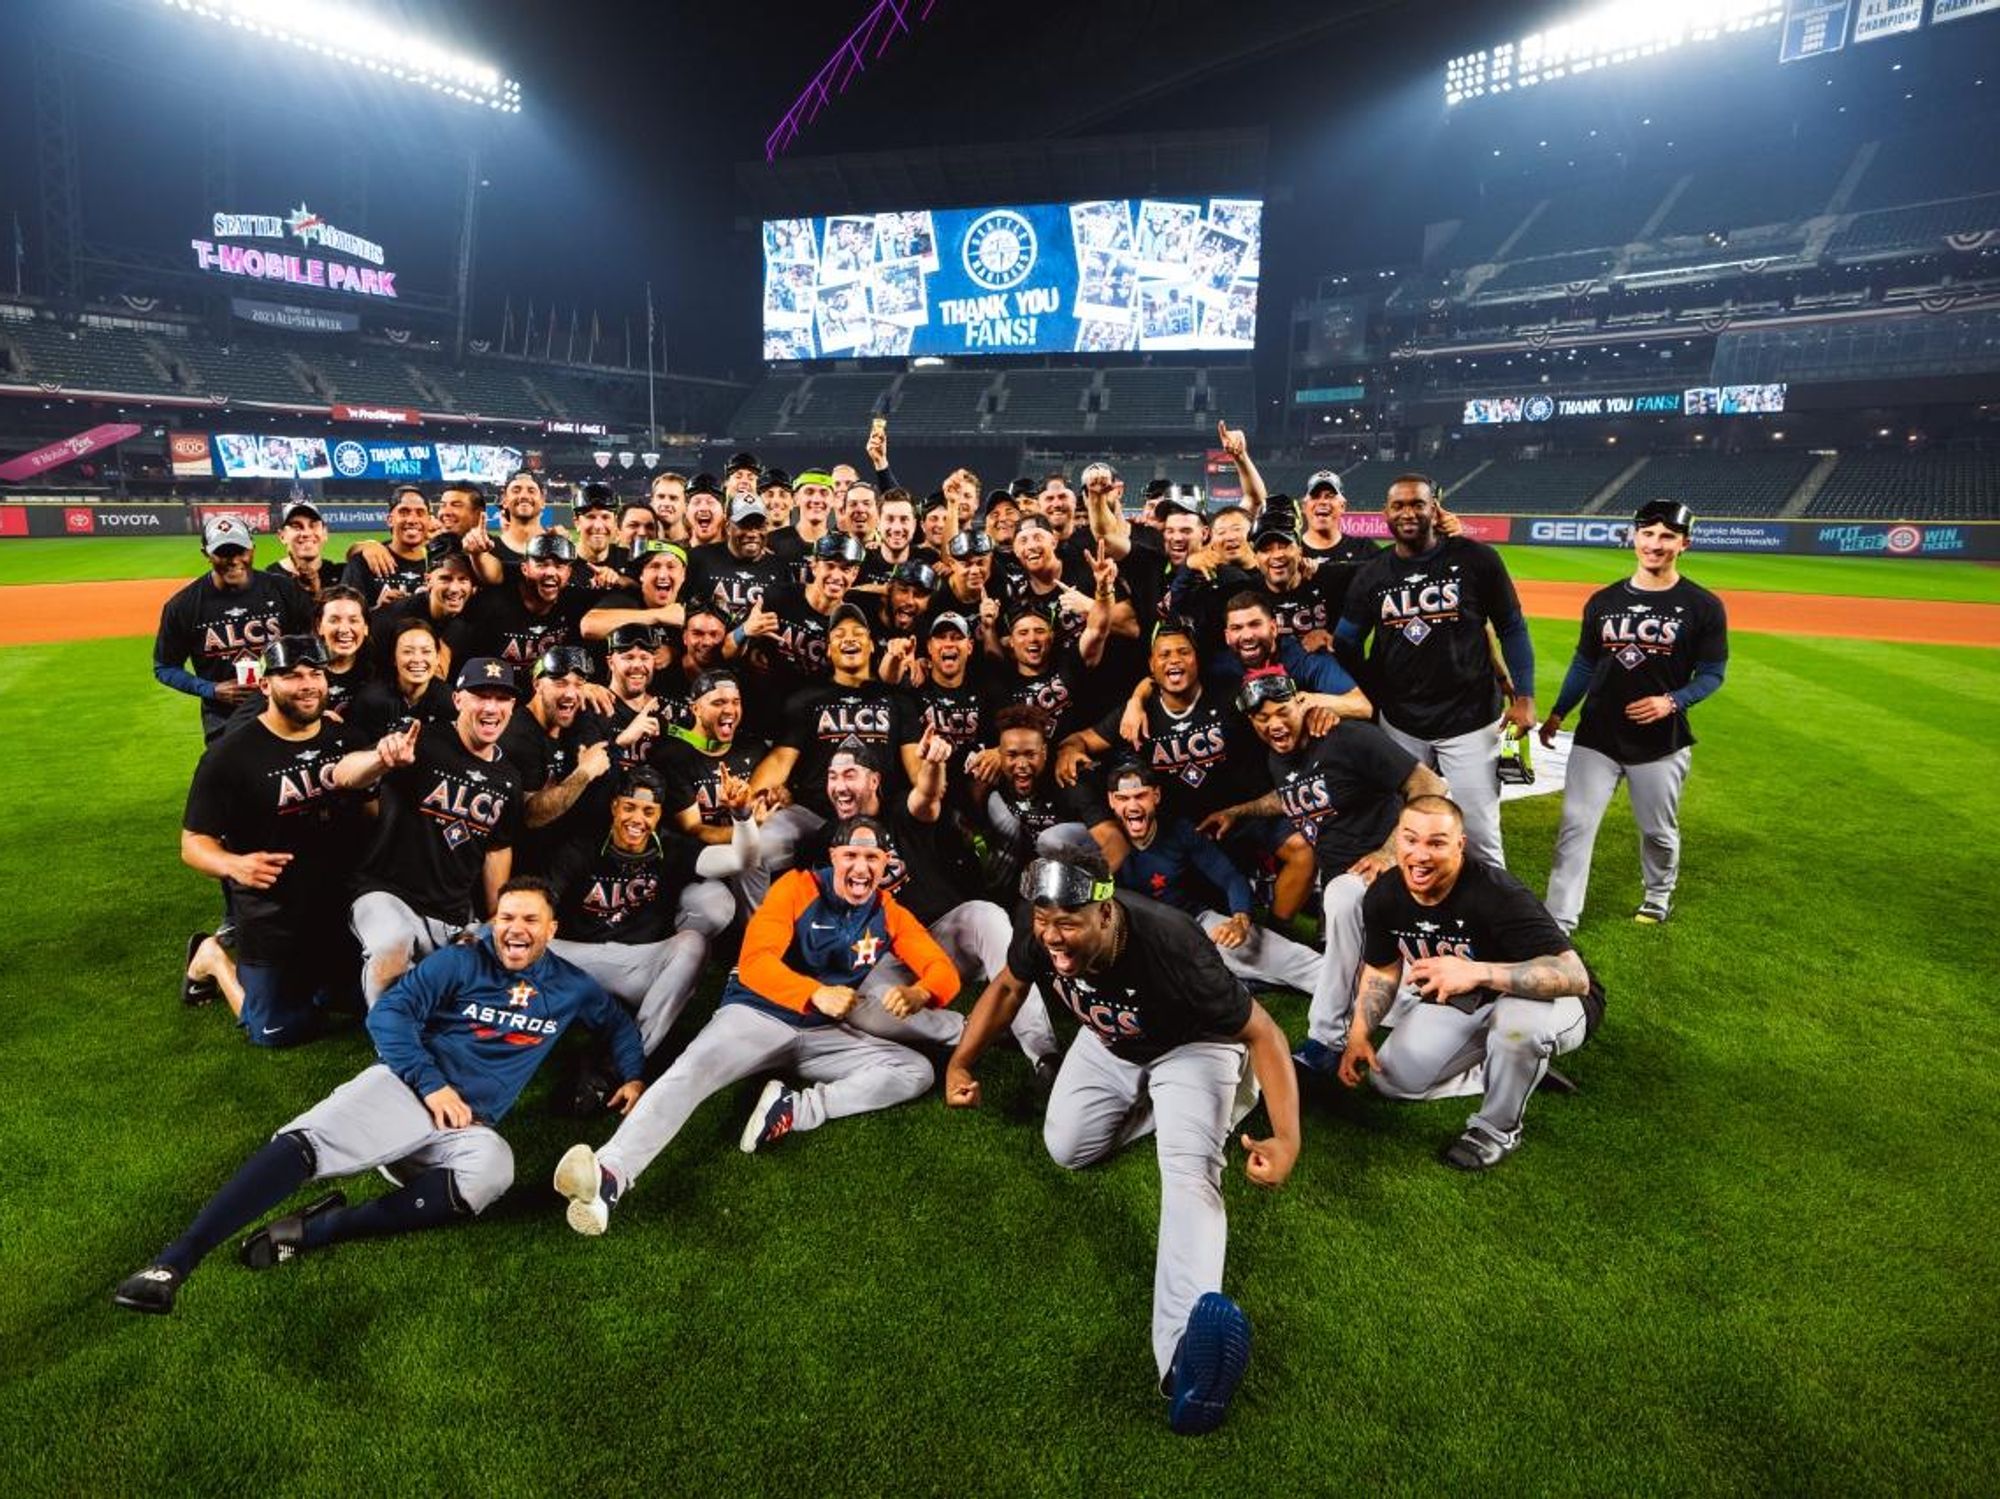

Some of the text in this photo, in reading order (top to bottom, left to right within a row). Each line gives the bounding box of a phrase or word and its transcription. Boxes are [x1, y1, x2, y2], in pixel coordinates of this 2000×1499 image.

[191, 239, 398, 298] T-MOBILE PARK
[938, 286, 1060, 326] THANK YOU
[965, 317, 1037, 348] FANS!
[1558, 399, 1602, 415] THANK
[1606, 397, 1633, 413] YOU
[1636, 395, 1680, 412] FANS!
[369, 447, 406, 462] THANK
[408, 446, 431, 460] YOU
[384, 460, 422, 475] FANS!
[98, 514, 160, 526] TOYOTA
[1924, 528, 1958, 542] WIN
[1692, 536, 1743, 545] ranciscan
[712, 580, 765, 613] ALC
[1381, 583, 1459, 620] ALCS
[204, 616, 282, 652] ALCS
[1275, 603, 1327, 634] LCS
[1601, 617, 1680, 645] ALCS
[817, 707, 891, 733] ALCS
[1152, 727, 1225, 764] ALCS
[278, 761, 337, 807] ALC
[422, 778, 505, 827] ALCS
[462, 1002, 558, 1034] ASTROS
